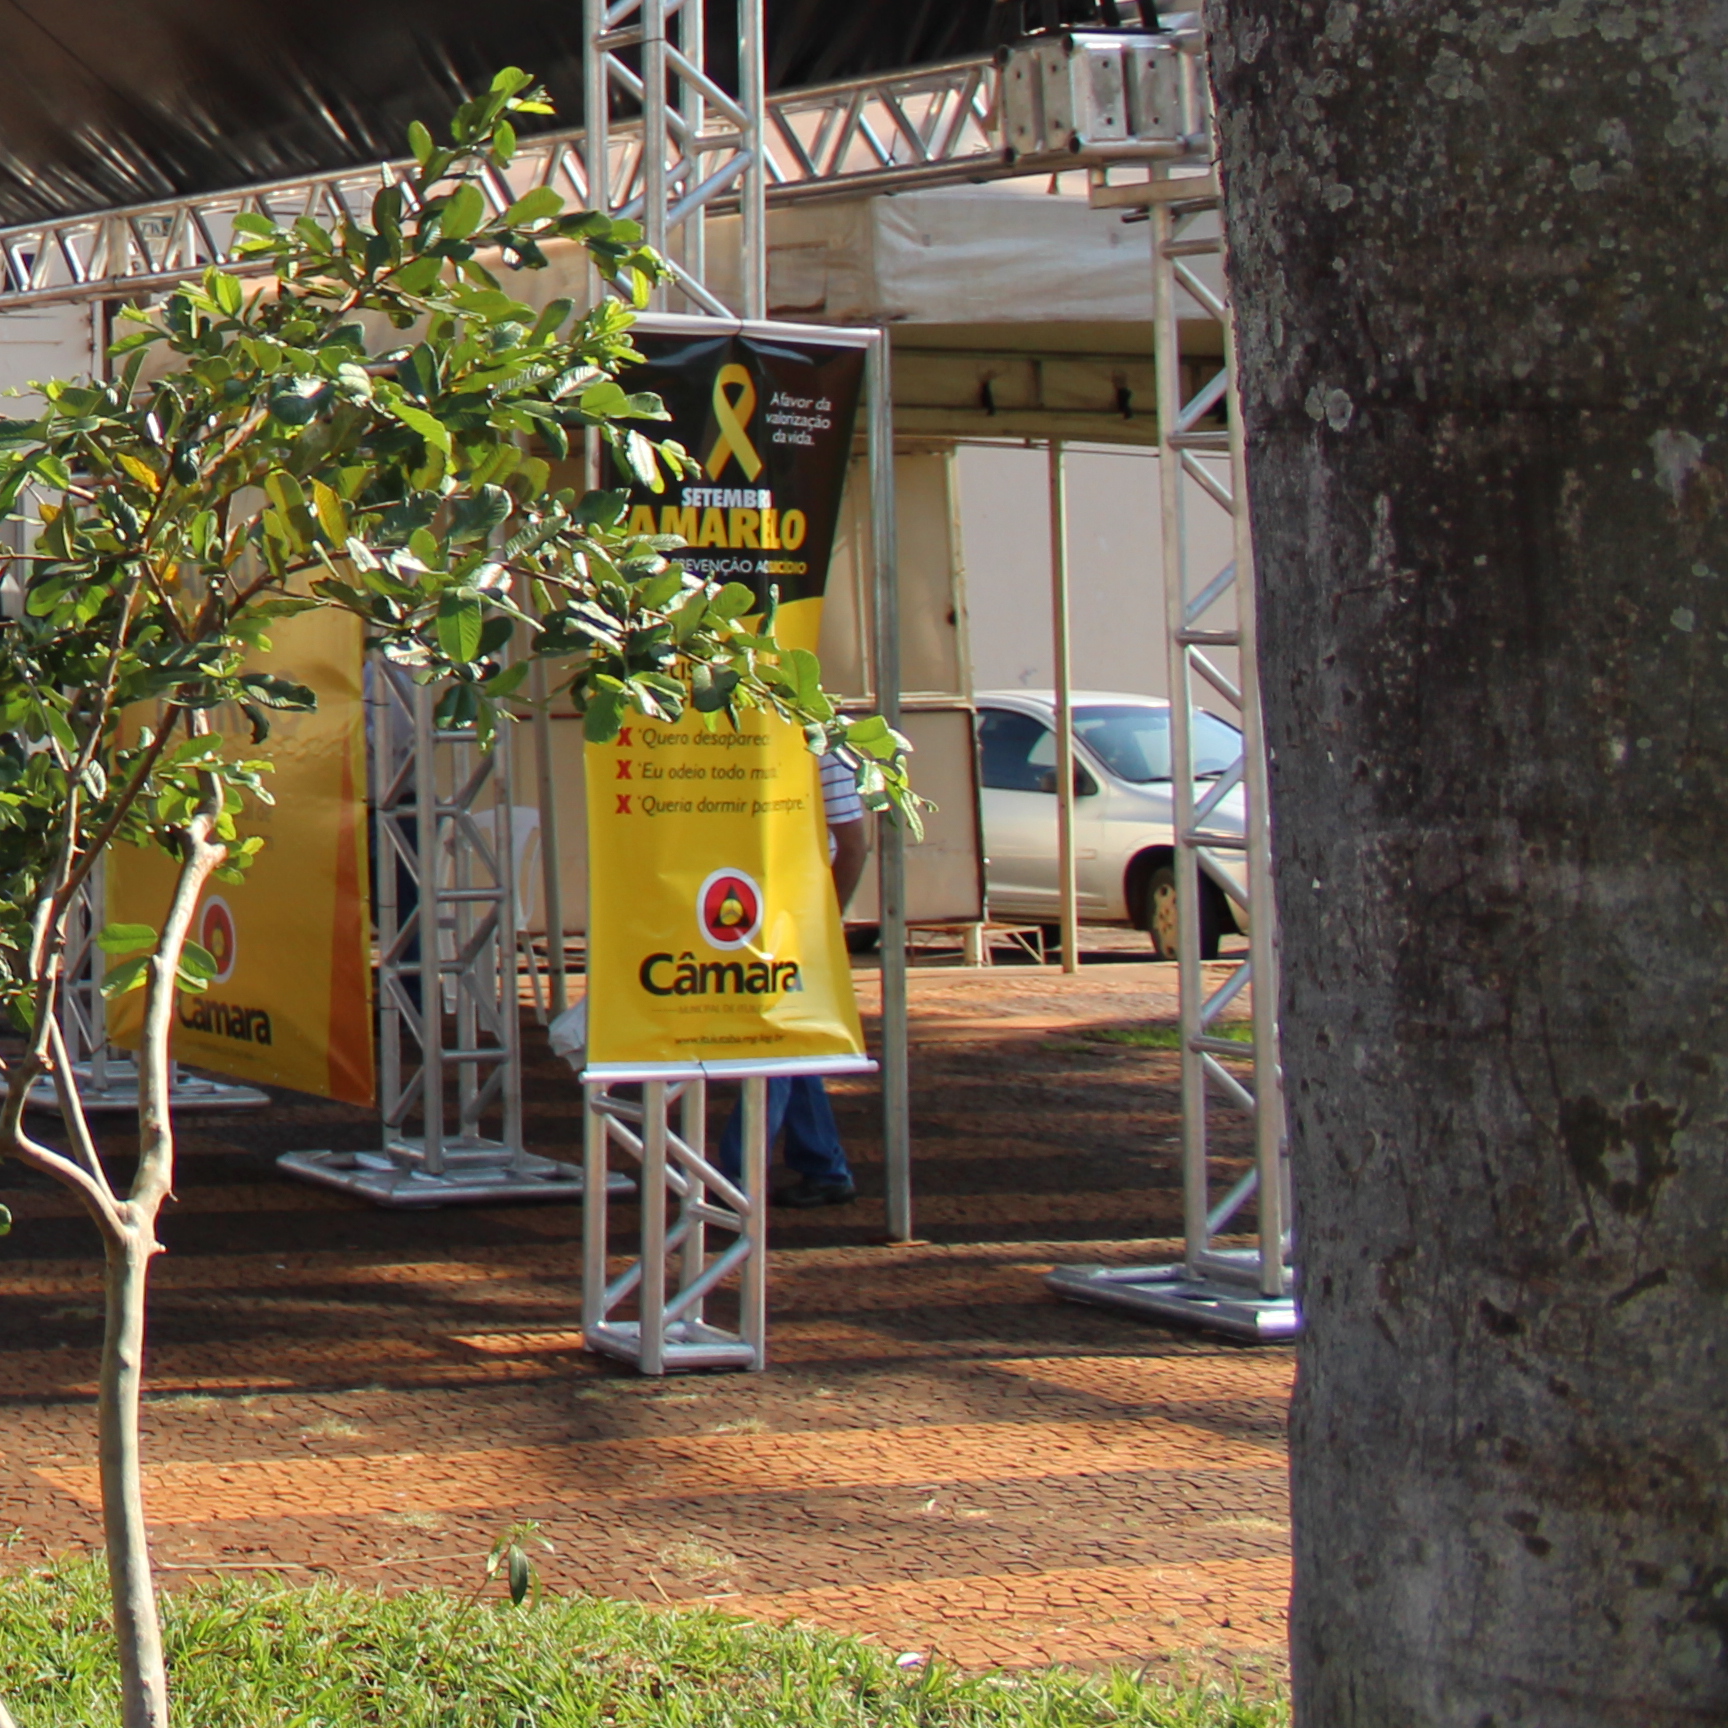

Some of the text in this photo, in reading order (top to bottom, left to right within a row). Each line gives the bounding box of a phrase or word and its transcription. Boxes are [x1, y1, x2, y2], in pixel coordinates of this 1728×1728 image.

[780, 392, 813, 408] favor
[815, 397, 831, 410] da
[772, 430, 786, 442] da
[668, 763, 706, 780] odeio
[711, 763, 745, 780] todo
[697, 796, 747, 814] dormir
[639, 950, 805, 996] Câmara
